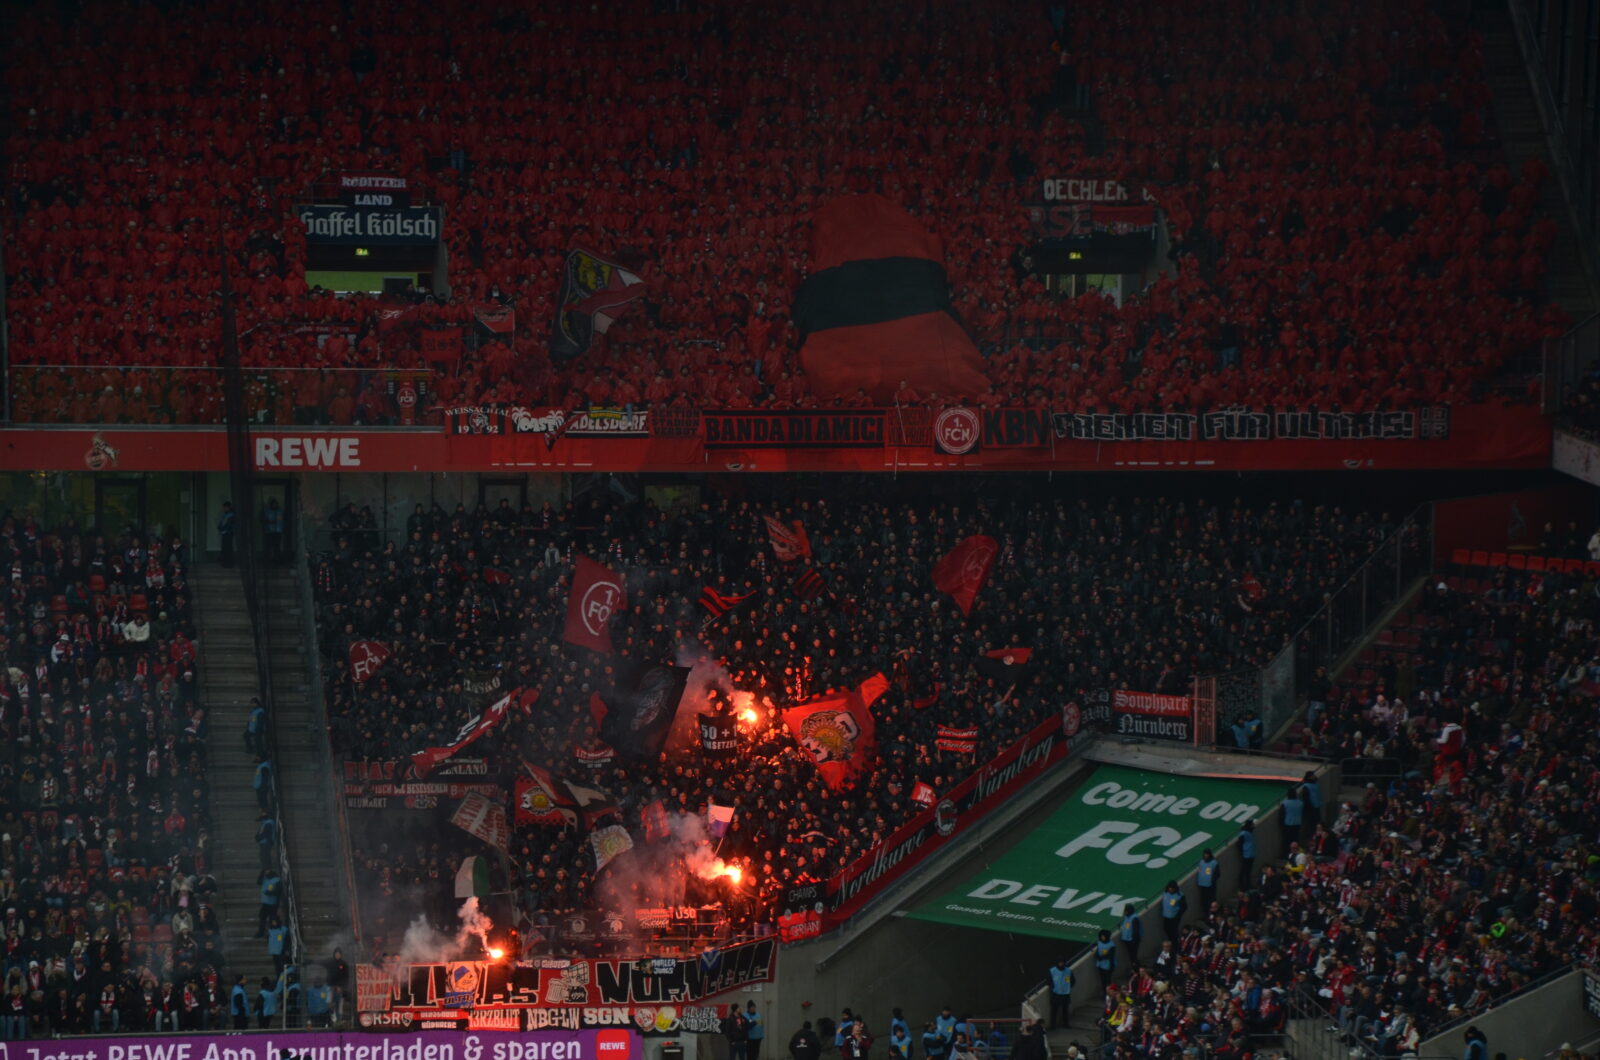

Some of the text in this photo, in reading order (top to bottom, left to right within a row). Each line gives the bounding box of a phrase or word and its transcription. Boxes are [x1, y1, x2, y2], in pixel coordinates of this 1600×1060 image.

[354, 193, 393, 206] LAND
[300, 210, 437, 239] Gaffel Kölsch
[457, 424, 500, 434] 19 92
[705, 417, 785, 441] BANDA
[787, 417, 812, 441] DI
[815, 417, 884, 441] AMICI
[944, 428, 970, 442] FCN
[952, 417, 963, 428] 1.
[983, 409, 1047, 445] KBN
[1203, 406, 1270, 440] FÜR
[255, 438, 361, 467] REWE
[701, 723, 717, 740] 50
[1117, 713, 1188, 741] Nürnberg
[967, 734, 1055, 810] Nürnberg
[1081, 780, 1261, 824] Come on
[1054, 819, 1213, 870] FC!
[831, 827, 926, 912] Nordkurve
[966, 877, 1148, 918] DEVK
[583, 1006, 631, 1025] SGN
[108, 1044, 191, 1060] REWE
[267, 1037, 454, 1060] herunterladen
[463, 1034, 484, 1058] &
[493, 1039, 582, 1060] sparen
[600, 1041, 626, 1051] REWE
